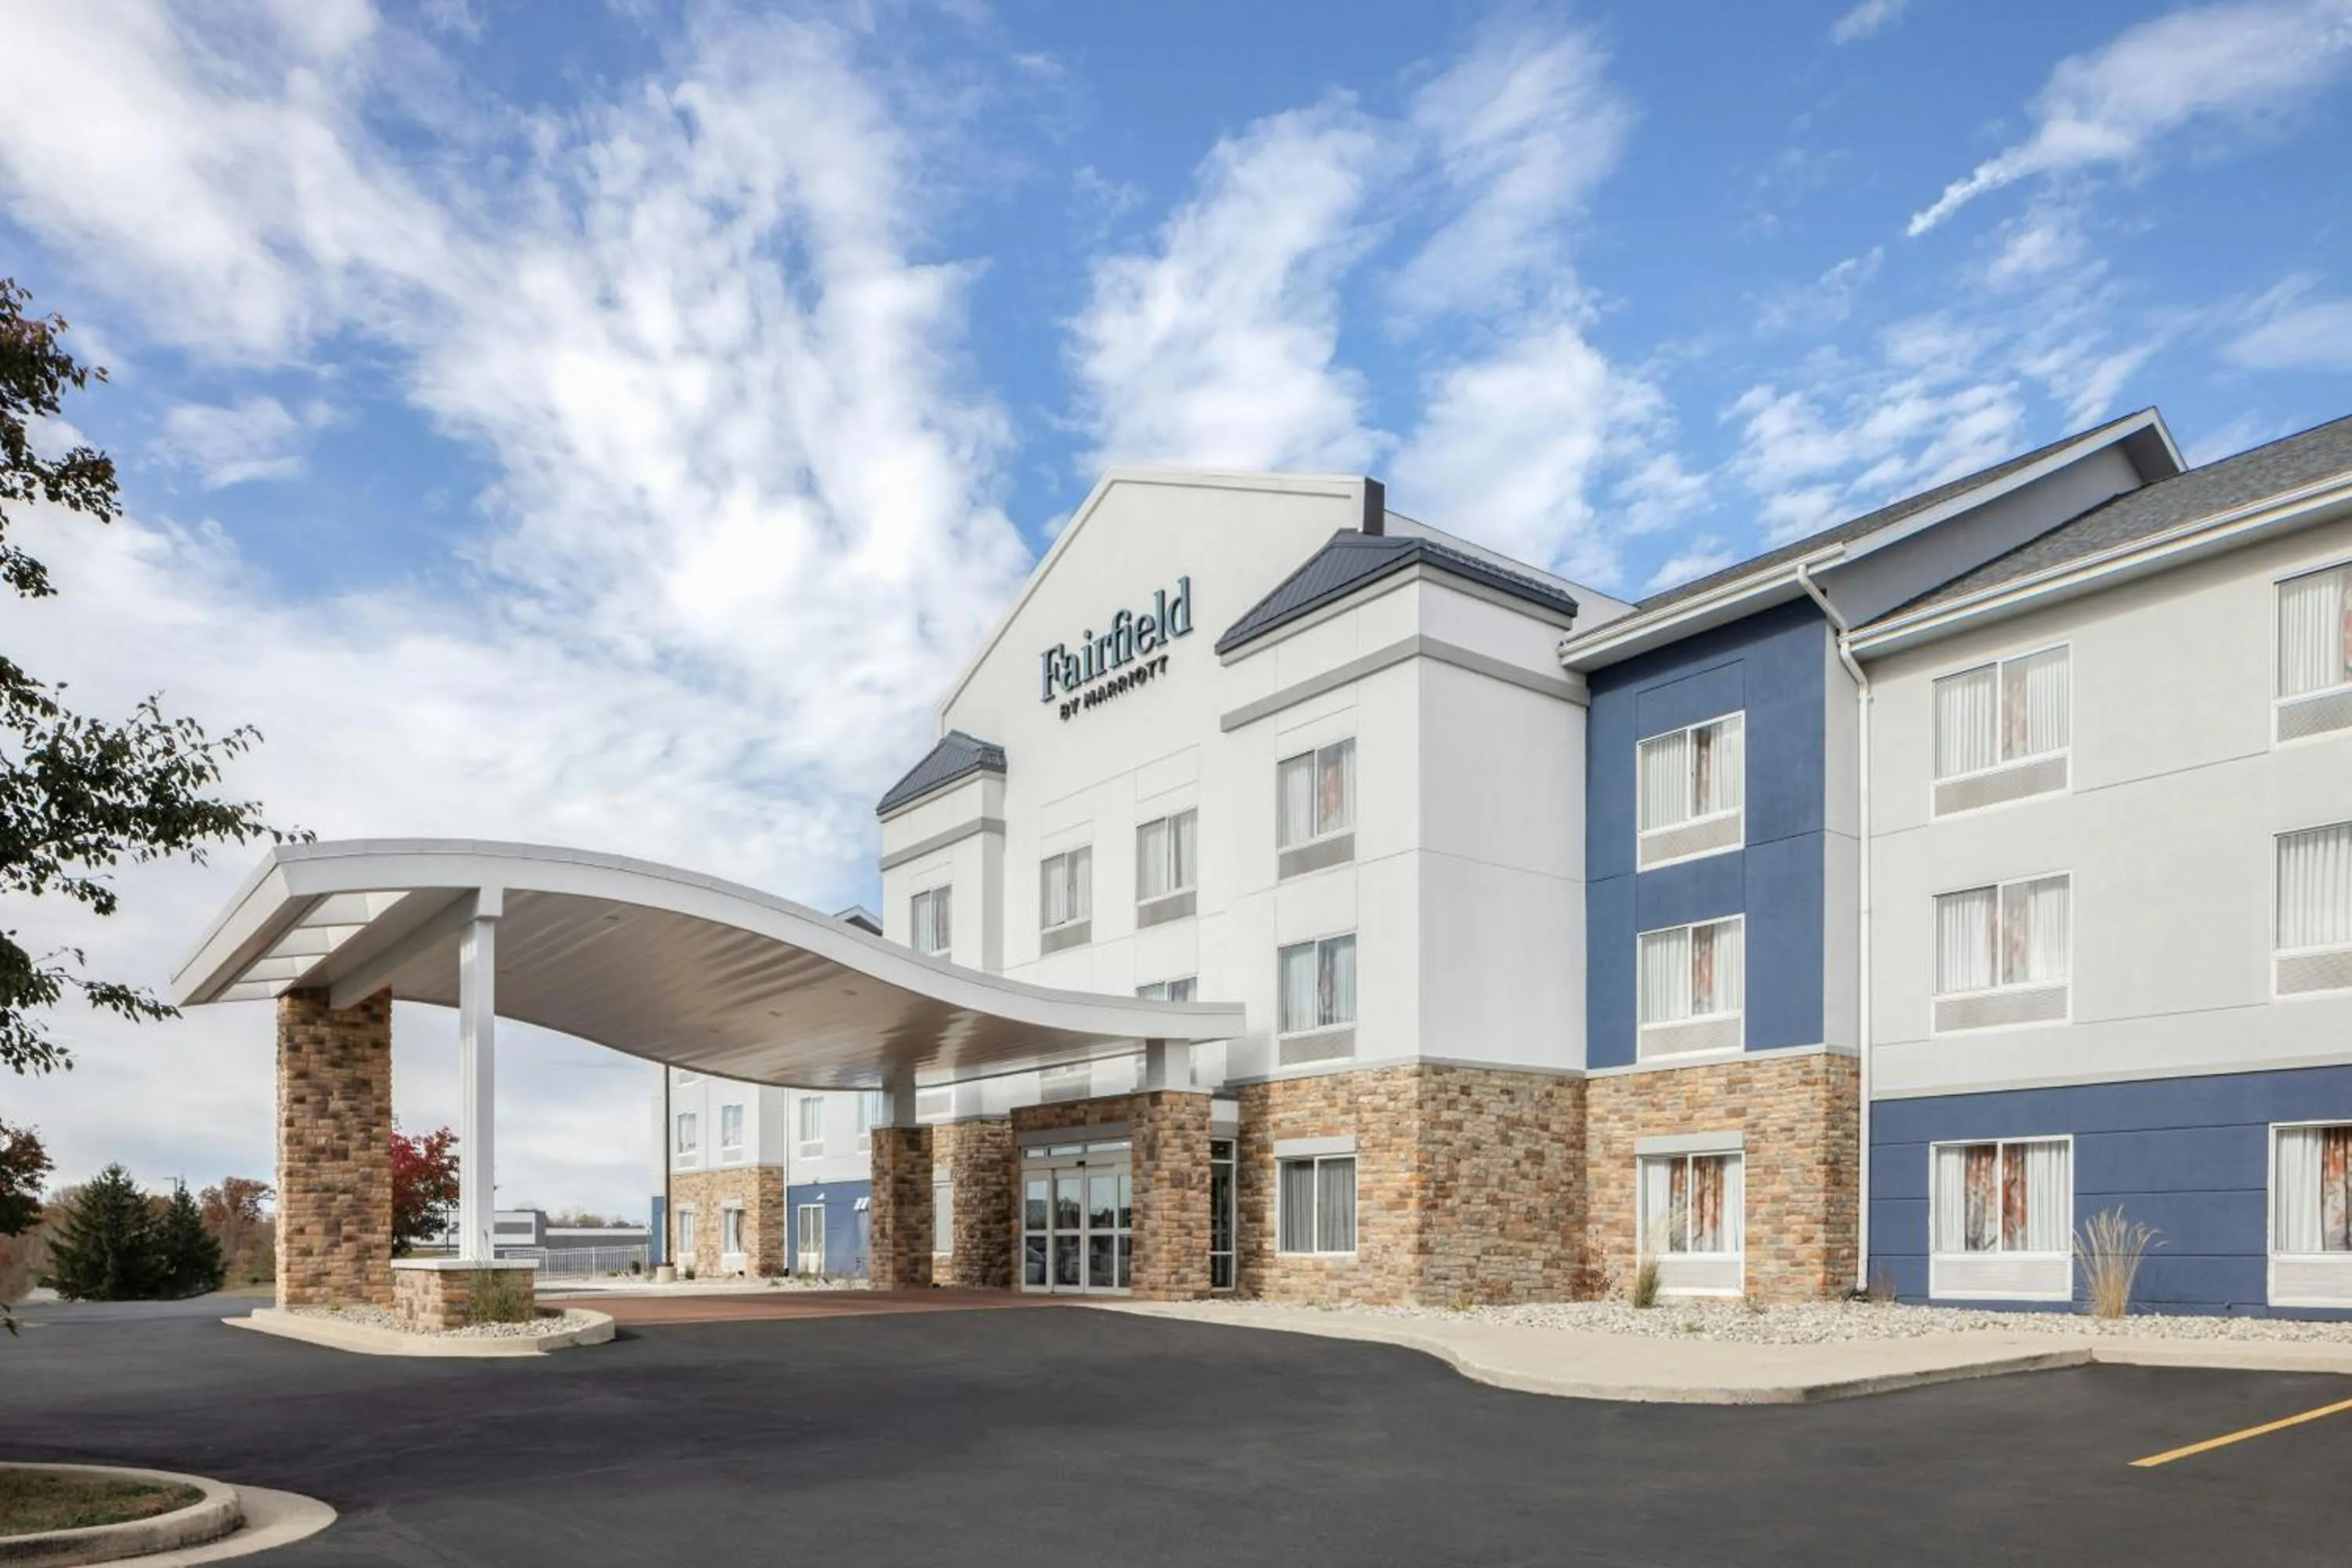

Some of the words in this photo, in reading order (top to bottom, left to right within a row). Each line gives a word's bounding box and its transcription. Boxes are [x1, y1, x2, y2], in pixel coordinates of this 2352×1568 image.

[1040, 575, 1193, 703] Fairfield
[1060, 697, 1080, 720] BY
[1083, 655, 1168, 709] MARRIOTT
